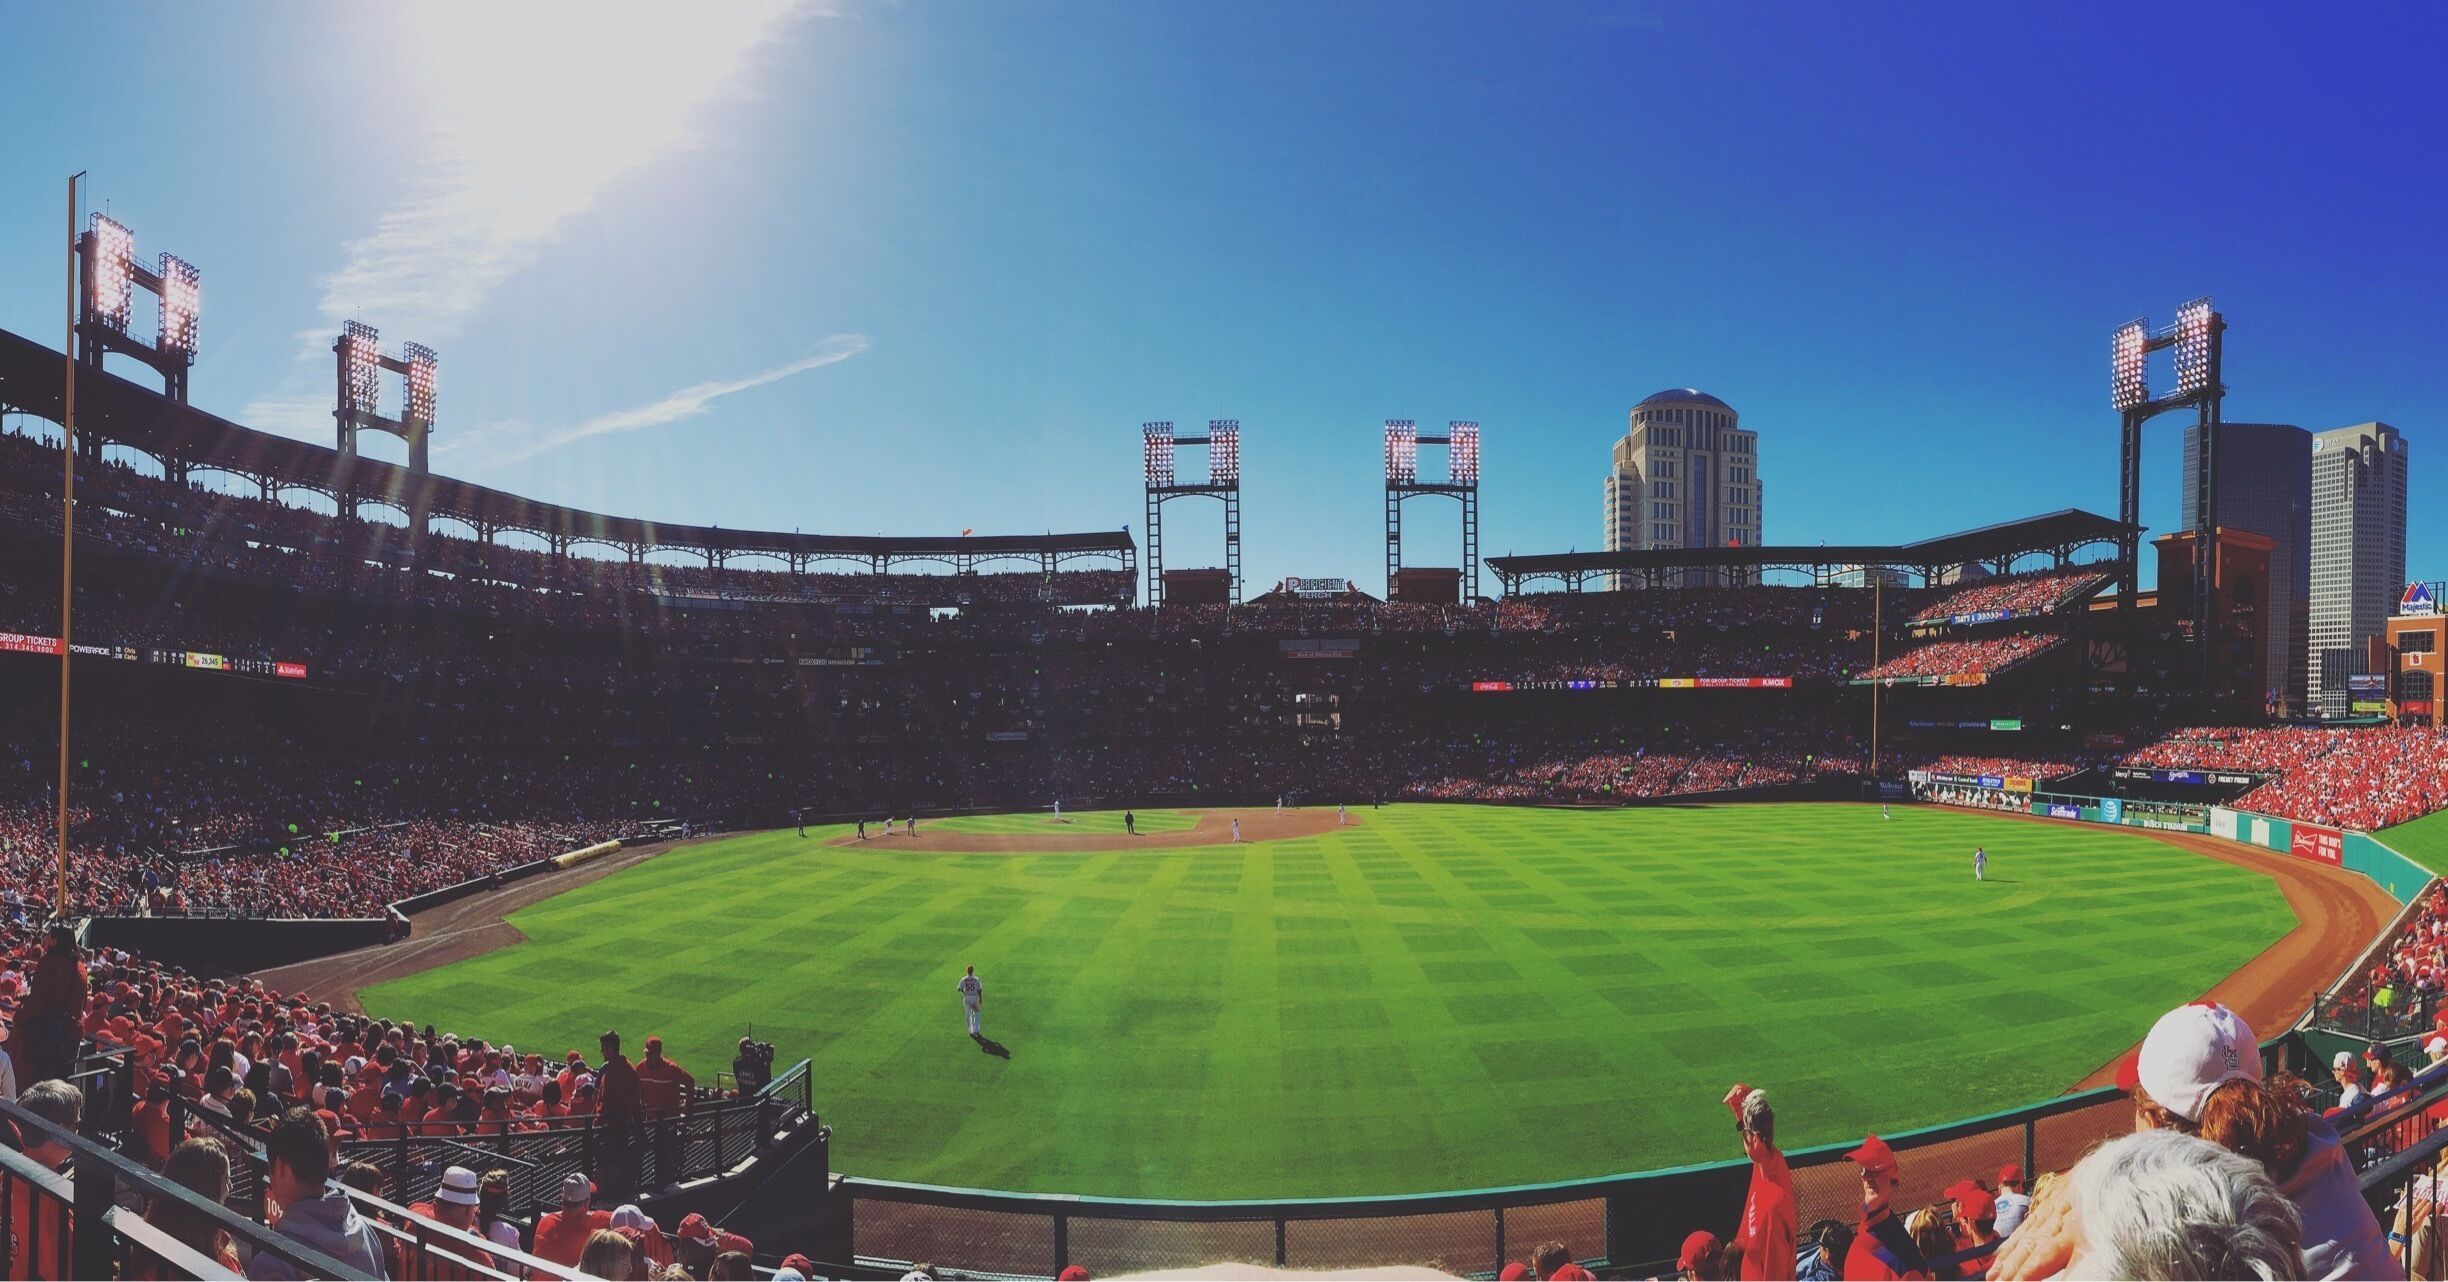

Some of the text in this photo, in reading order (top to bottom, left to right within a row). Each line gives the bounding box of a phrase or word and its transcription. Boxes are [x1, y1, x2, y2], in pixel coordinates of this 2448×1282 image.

[1286, 577, 1344, 593] PERFICIENT
[2402, 603, 2433, 612] Majestic
[0, 633, 57, 647] GROUP TICKETS
[69, 644, 109, 656] POWERADE
[1762, 678, 1785, 687] KMOX
[1880, 781, 1903, 790] Webster
[2050, 806, 2077, 819] Scottrade
[2318, 834, 2328, 846] THIS
[2318, 845, 2327, 857] FOR
